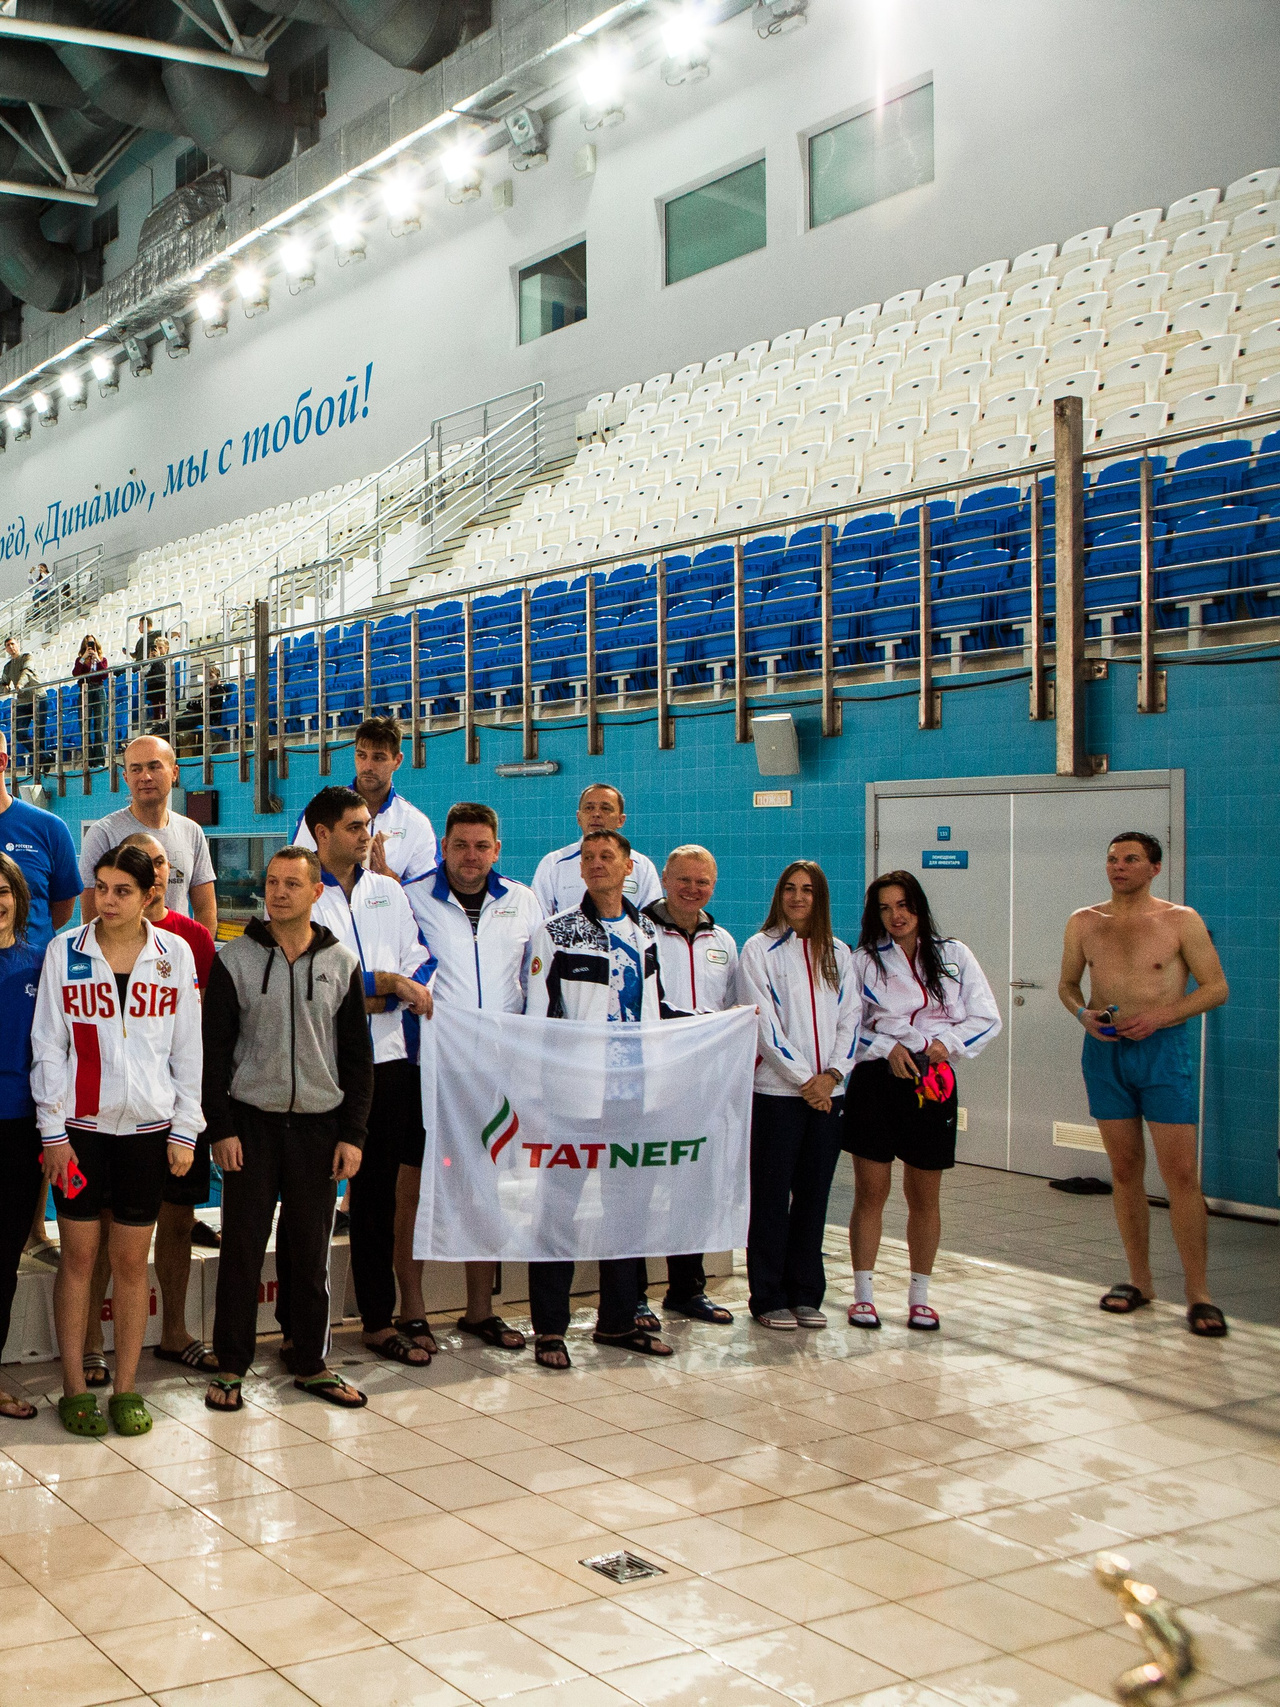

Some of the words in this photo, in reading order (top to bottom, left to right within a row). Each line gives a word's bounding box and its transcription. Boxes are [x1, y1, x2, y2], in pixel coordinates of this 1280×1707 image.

[34, 480, 155, 556] «Динамо»,
[162, 449, 208, 498] мы
[218, 438, 233, 475] с
[241, 361, 373, 466] тобой!
[62, 982, 178, 1018] RUSSIA
[521, 1136, 708, 1170] TATNEFT
